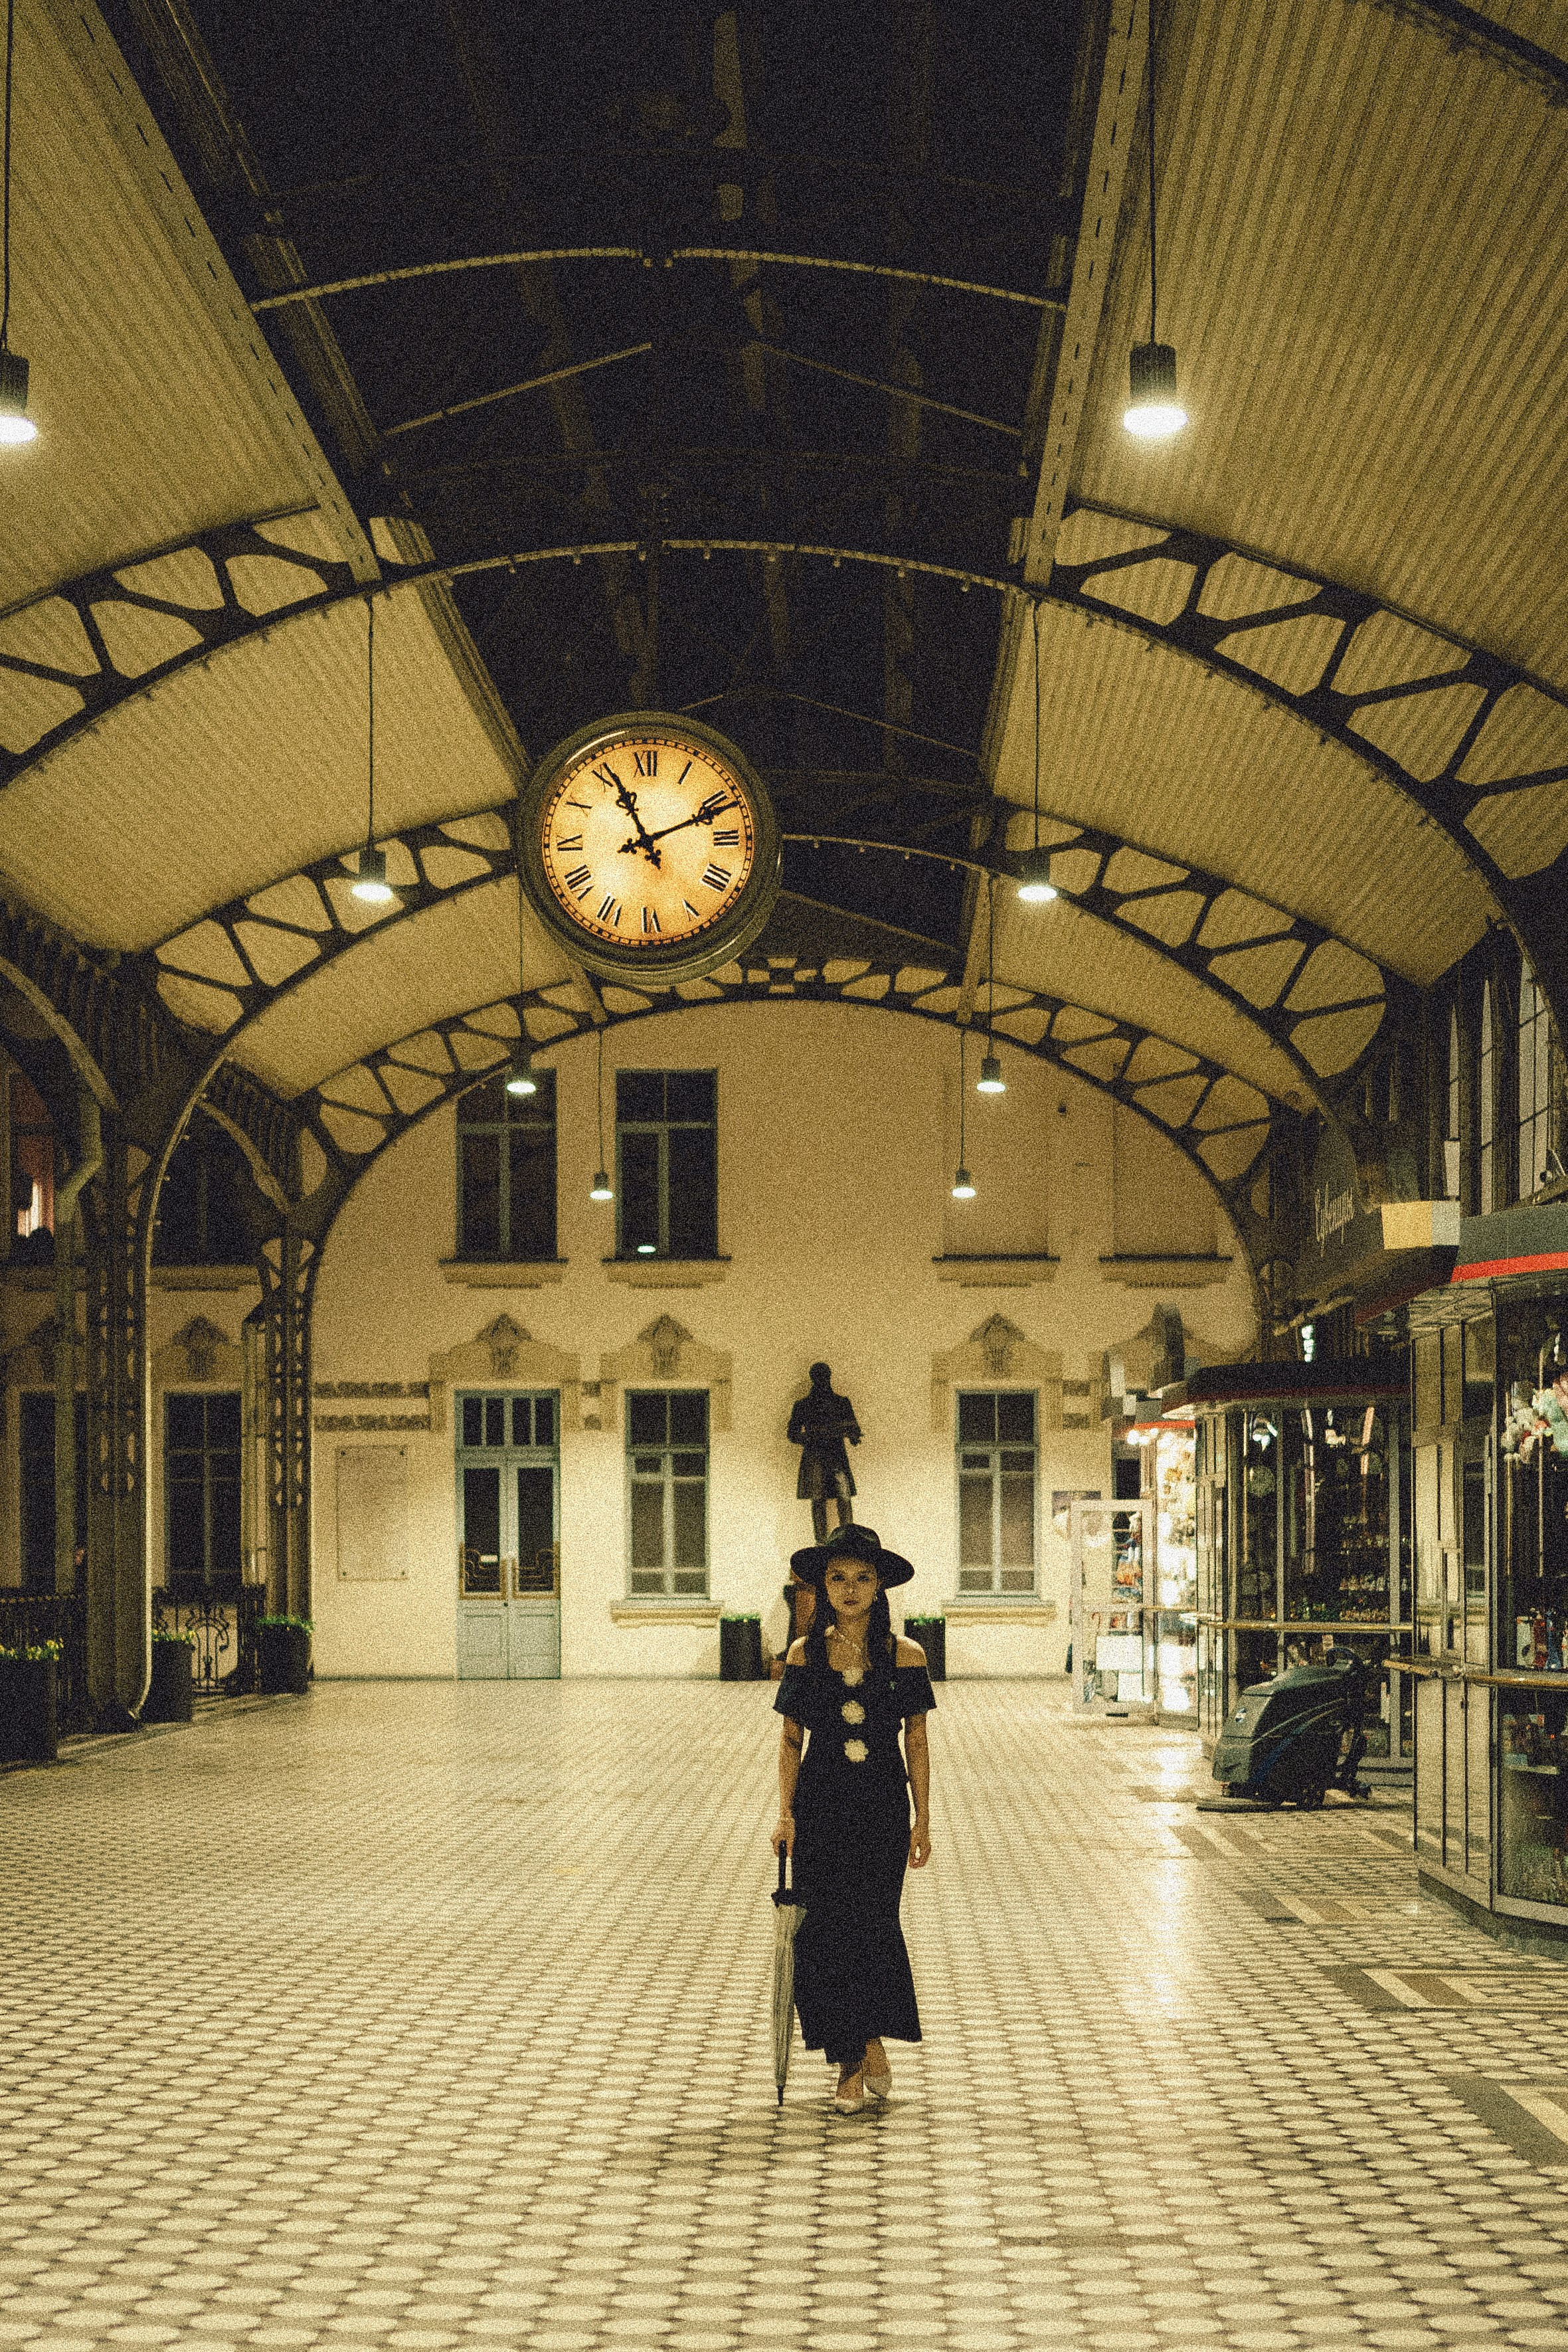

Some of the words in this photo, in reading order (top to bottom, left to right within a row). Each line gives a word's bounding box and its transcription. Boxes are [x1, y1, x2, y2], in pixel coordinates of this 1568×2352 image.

[633, 750, 658, 777] XII
[678, 760, 693, 785] I
[565, 794, 592, 818] X
[557, 834, 583, 851] IX
[713, 829, 739, 847] III
[563, 863, 594, 901] VIII
[701, 863, 732, 893] IIII
[597, 895, 623, 928] VII
[642, 907, 661, 933] VI
[683, 899, 700, 922] V
